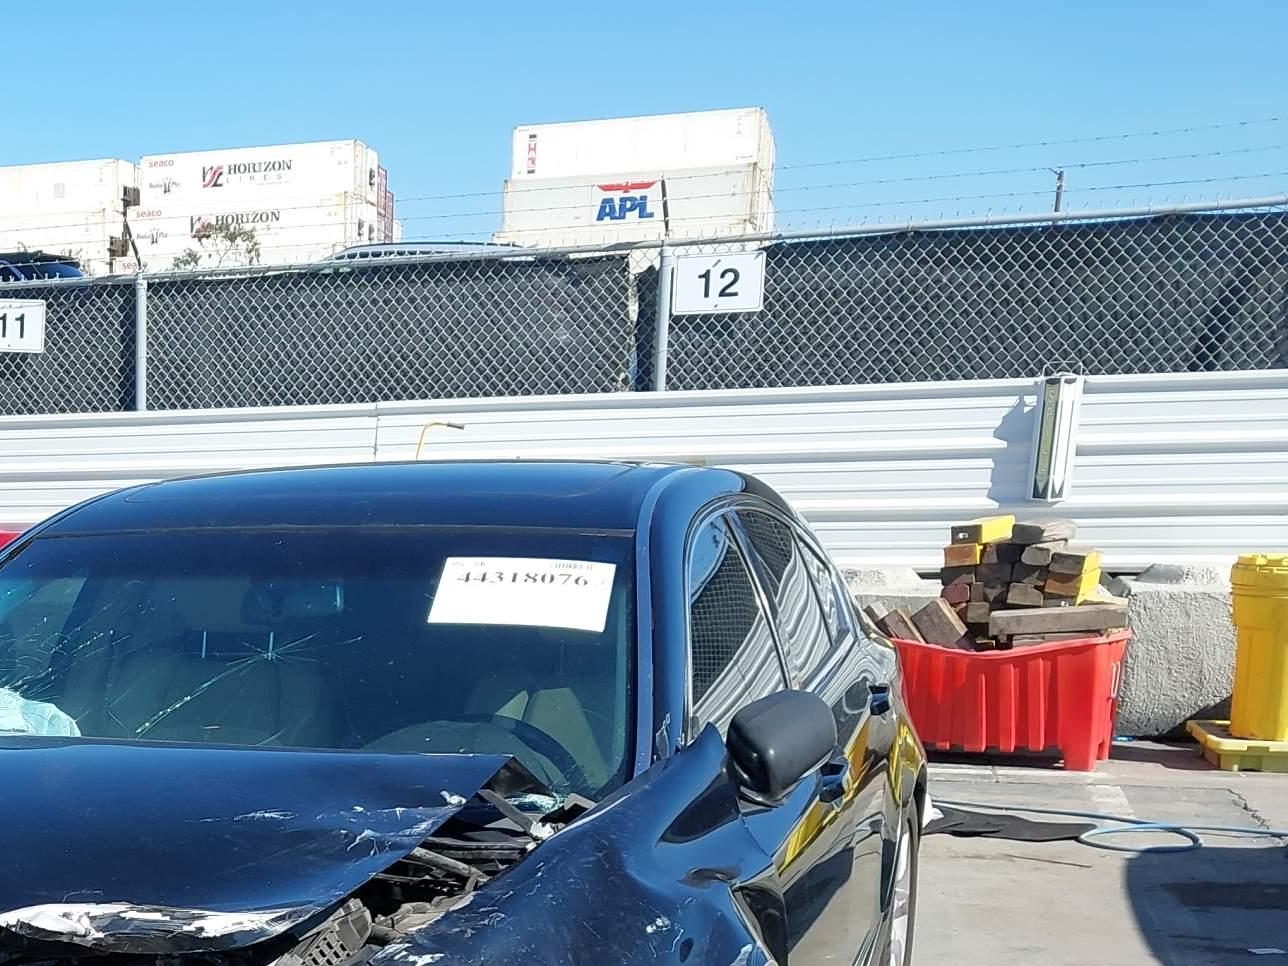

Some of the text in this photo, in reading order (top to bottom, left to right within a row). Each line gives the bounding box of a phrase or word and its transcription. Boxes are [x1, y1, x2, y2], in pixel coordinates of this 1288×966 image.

[148, 159, 174, 168] seaco
[227, 159, 293, 175] HORIZON
[226, 173, 282, 184] LINES
[136, 209, 162, 218] seaco
[596, 195, 655, 222] APL
[215, 211, 281, 226] HORIZON
[698, 268, 740, 298] 12
[456, 571, 589, 586] 44318076
